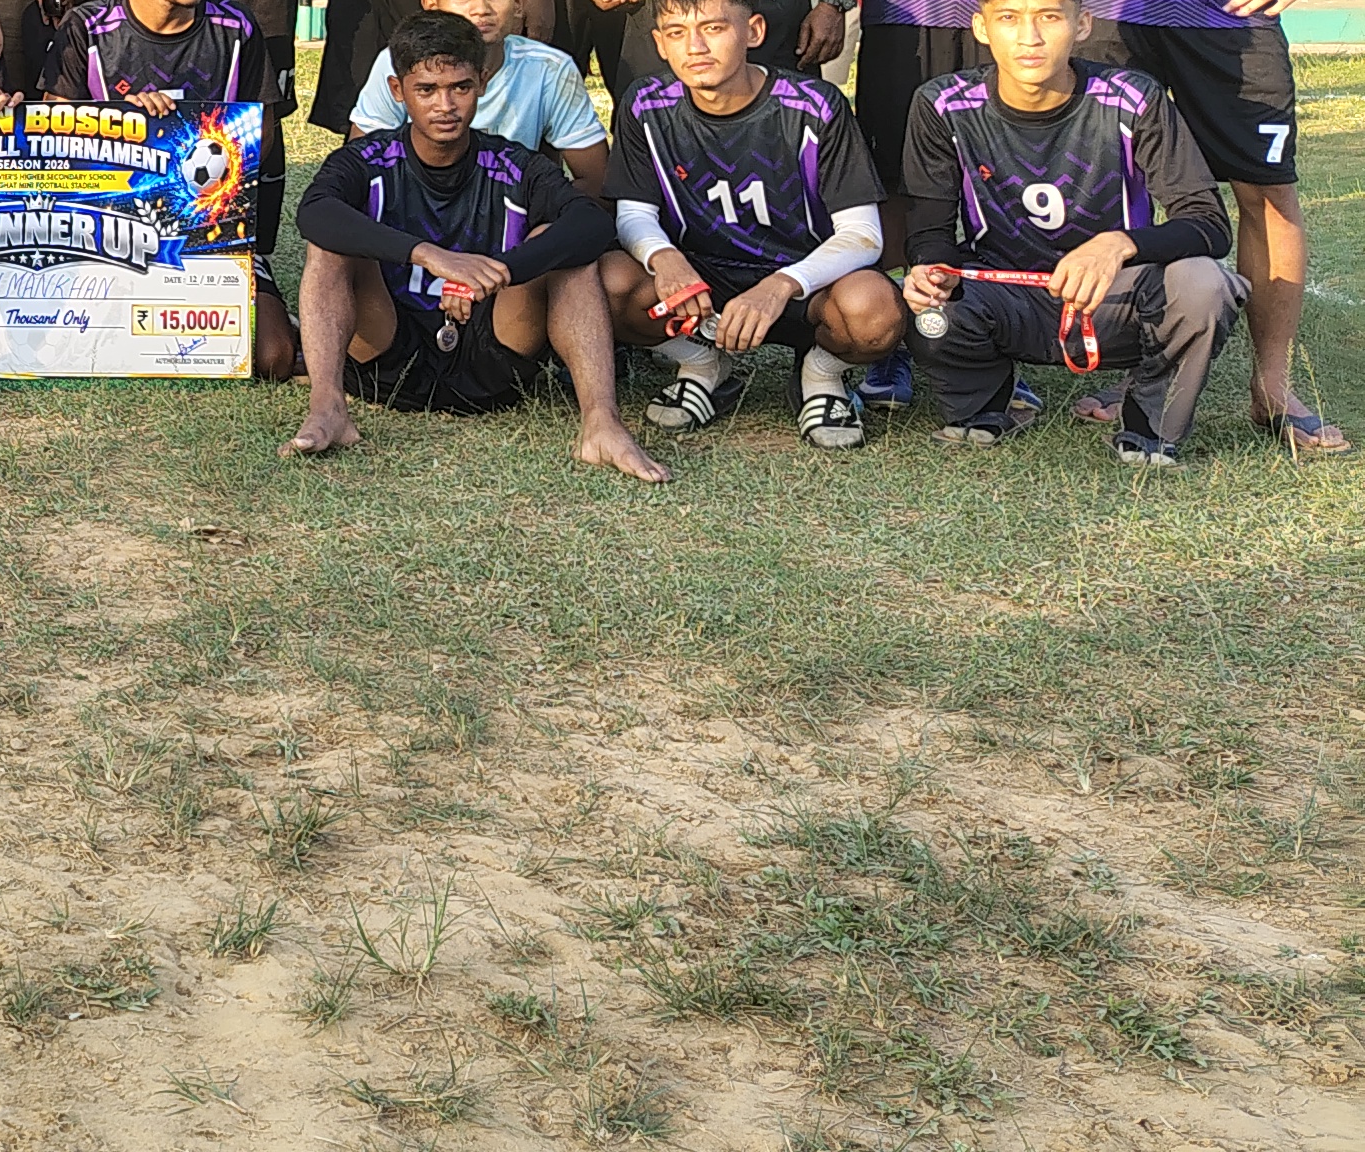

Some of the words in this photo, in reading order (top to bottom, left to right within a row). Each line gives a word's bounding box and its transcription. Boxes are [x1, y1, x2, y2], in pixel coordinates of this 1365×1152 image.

[24, 104, 148, 143] BOSCO
[26, 134, 172, 175] TOURNAMENT
[1257, 124, 1290, 164] 7
[19, 173, 43, 181] HIGHER
[46, 173, 88, 181] SECONDARY
[89, 173, 117, 181] SCHOOL
[44, 158, 70, 170] 2026
[35, 181, 69, 190] FOOTBALL
[70, 181, 100, 190] STADIUM
[706, 180, 771, 228] 11
[1021, 183, 1066, 231] 9
[103, 213, 160, 268] UP
[222, 275, 240, 284] 2026
[5, 308, 60, 326] Thousand
[62, 309, 91, 333] Only
[159, 309, 236, 334] 15,000/-
